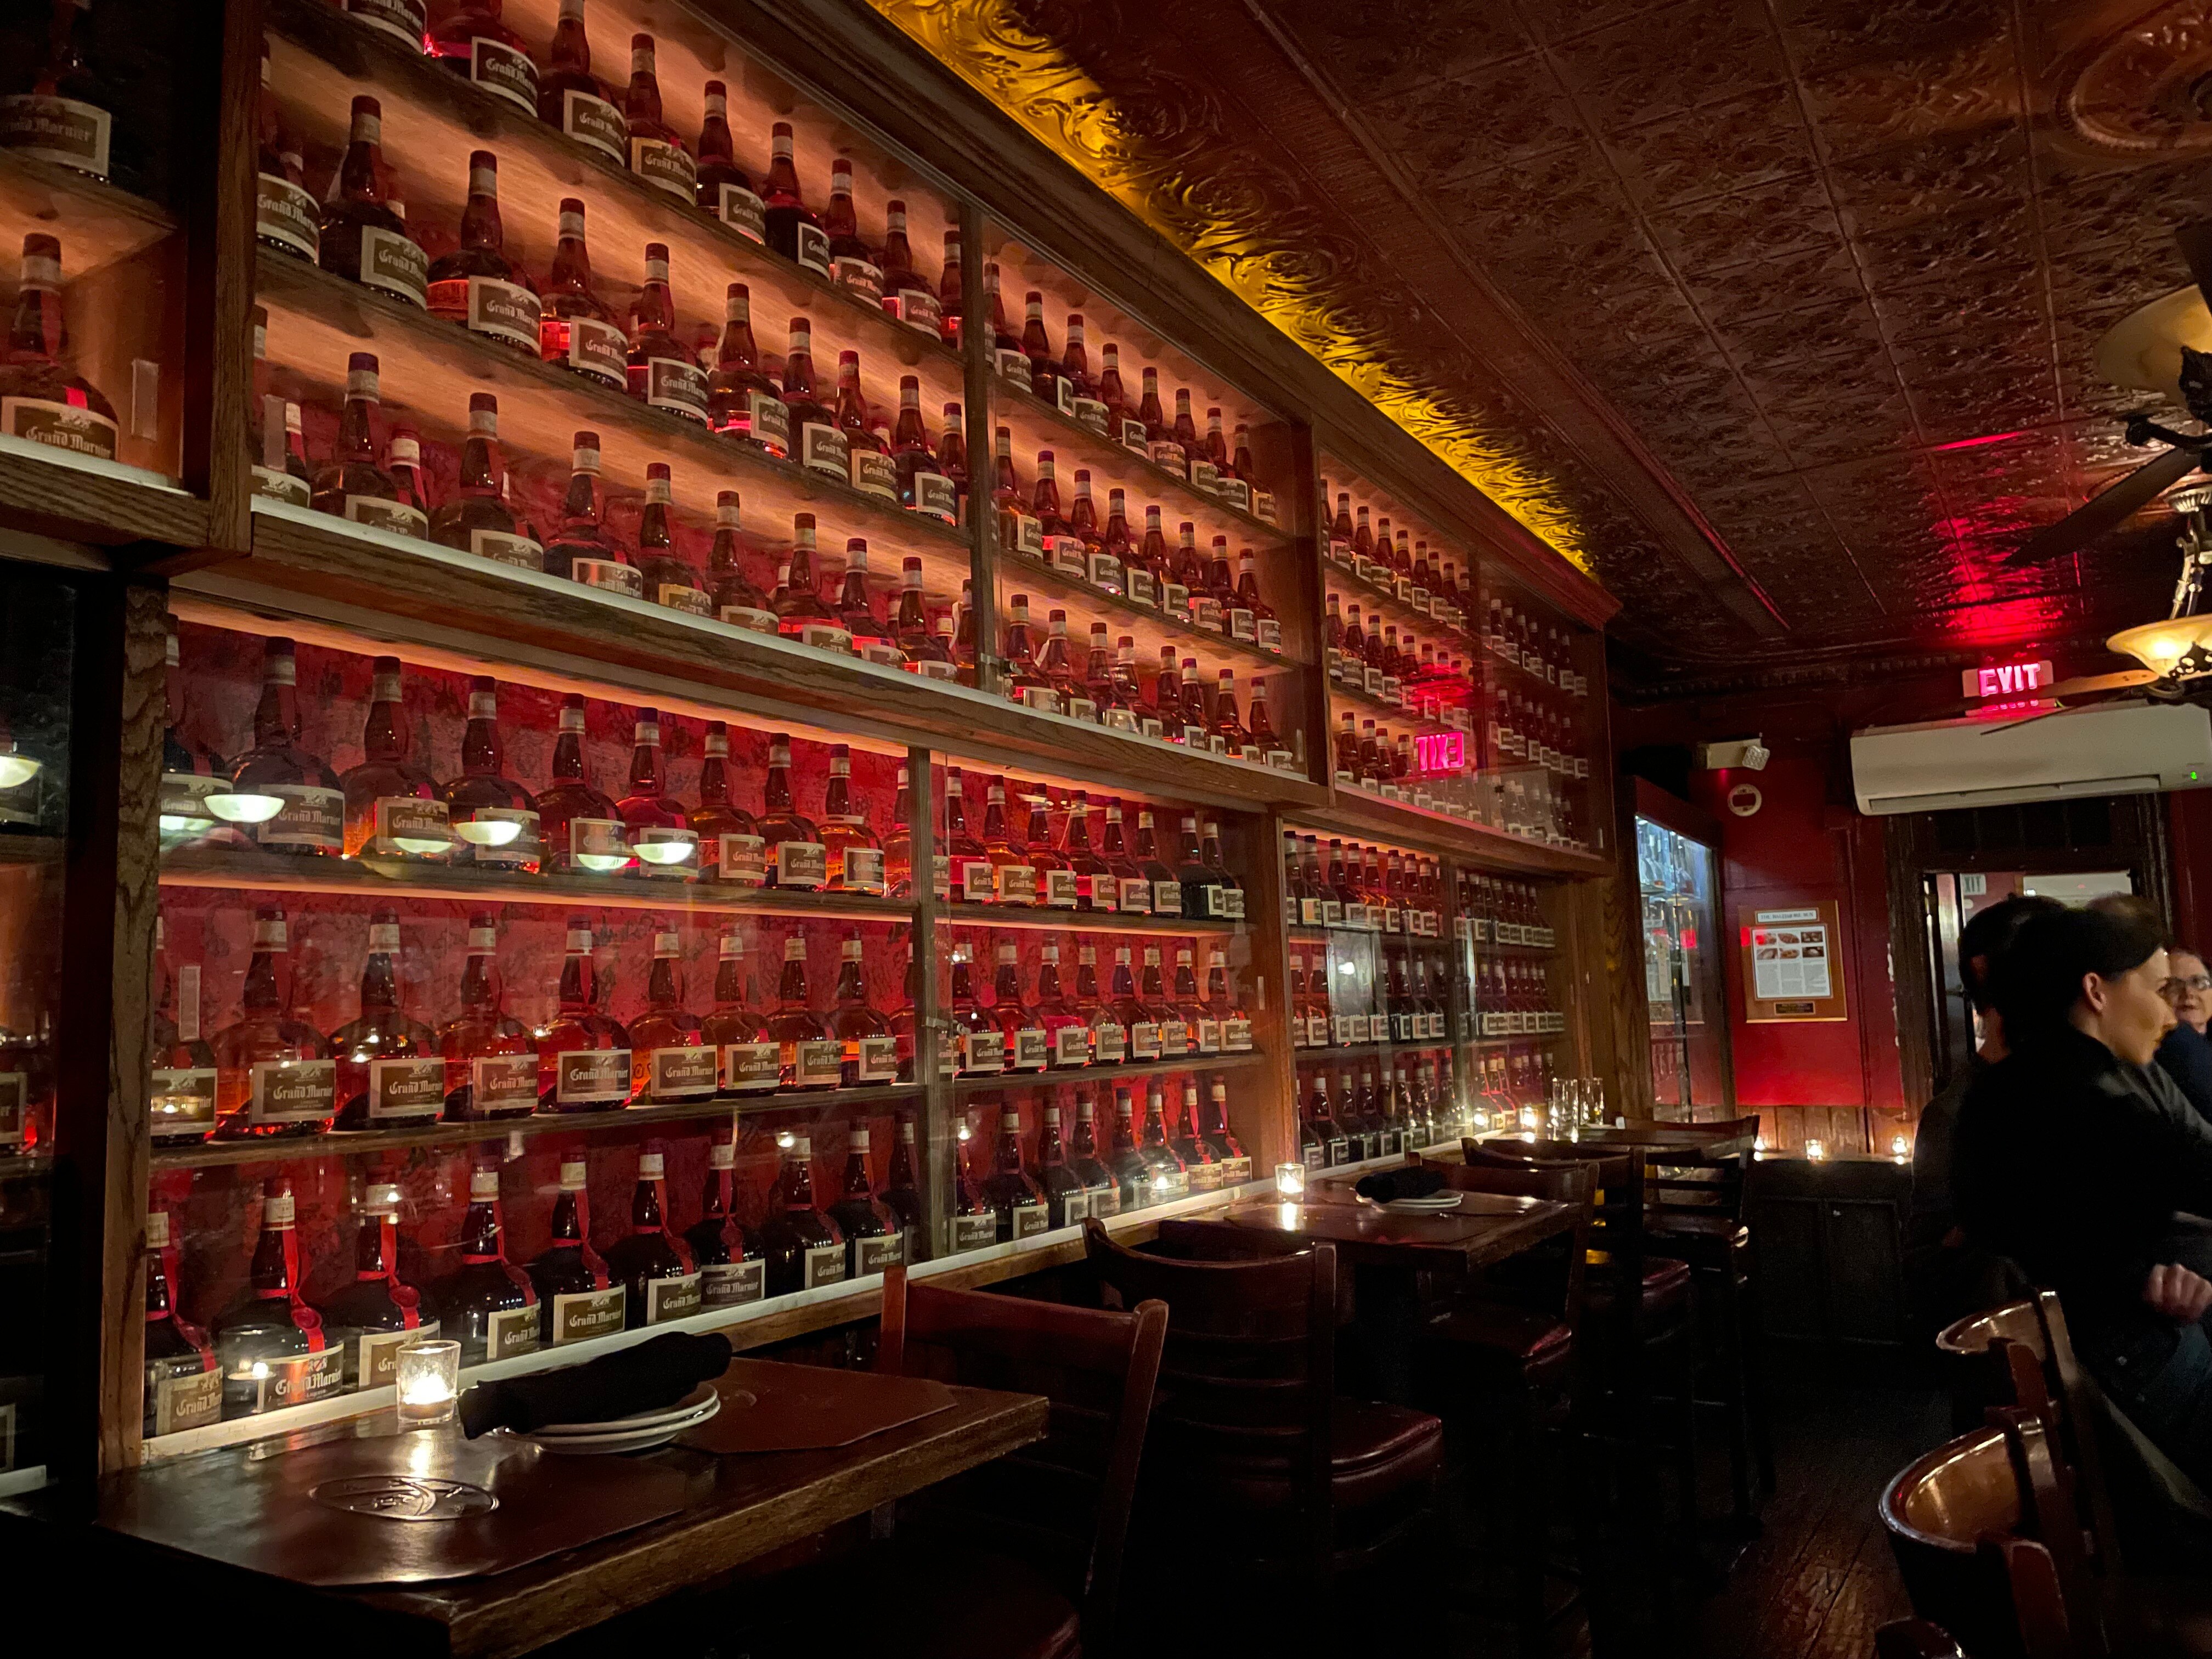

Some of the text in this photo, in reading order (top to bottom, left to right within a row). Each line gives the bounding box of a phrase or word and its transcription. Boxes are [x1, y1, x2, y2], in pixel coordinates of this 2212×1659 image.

[25, 425, 69, 447] Grand
[1978, 663, 2041, 697] EXIT
[665, 1066, 691, 1079] Grand
[389, 1081, 419, 1094] Grand
[489, 1077, 517, 1090] Grand
[274, 1085, 306, 1100] Grand
[569, 1314, 597, 1328] Grand
[176, 1396, 207, 1417] Grand
